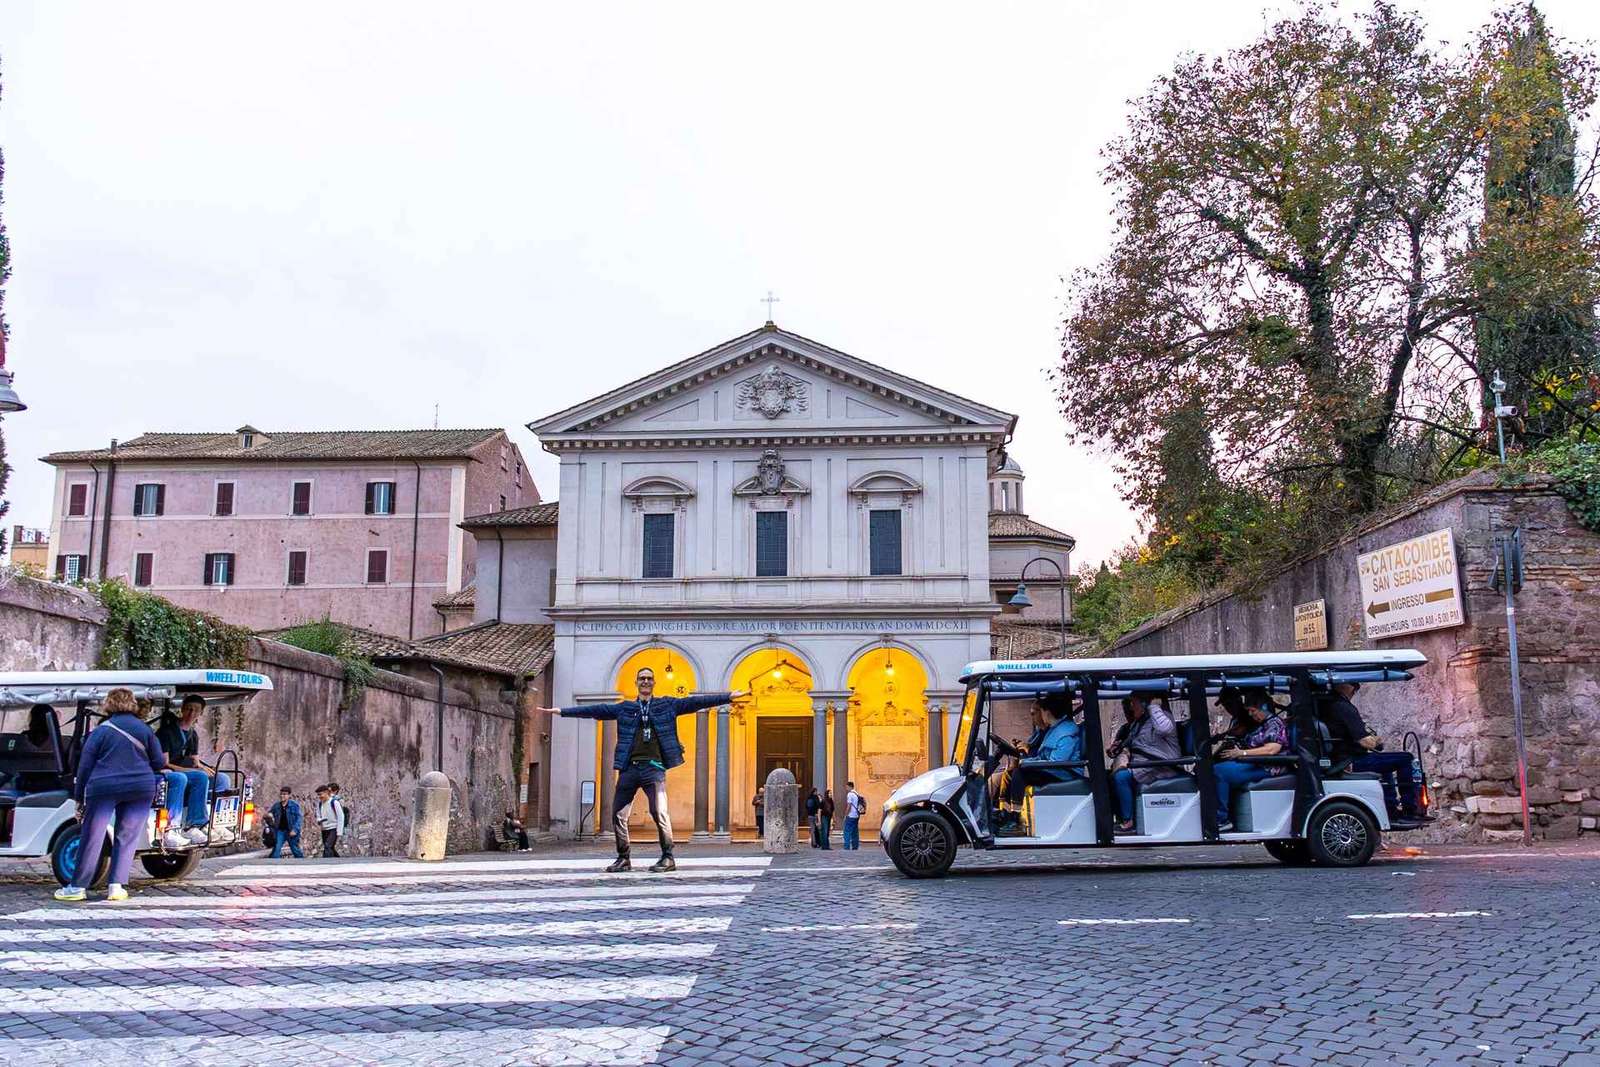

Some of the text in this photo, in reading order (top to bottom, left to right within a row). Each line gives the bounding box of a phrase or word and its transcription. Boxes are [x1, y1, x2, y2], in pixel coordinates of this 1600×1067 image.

[1371, 534, 1450, 575] CATACOMBE
[1373, 559, 1453, 592] SAN SEBASTIANO
[1391, 593, 1425, 610] INGRESSO
[1368, 623, 1391, 636] OPENING
[1391, 619, 1409, 633] HOURS
